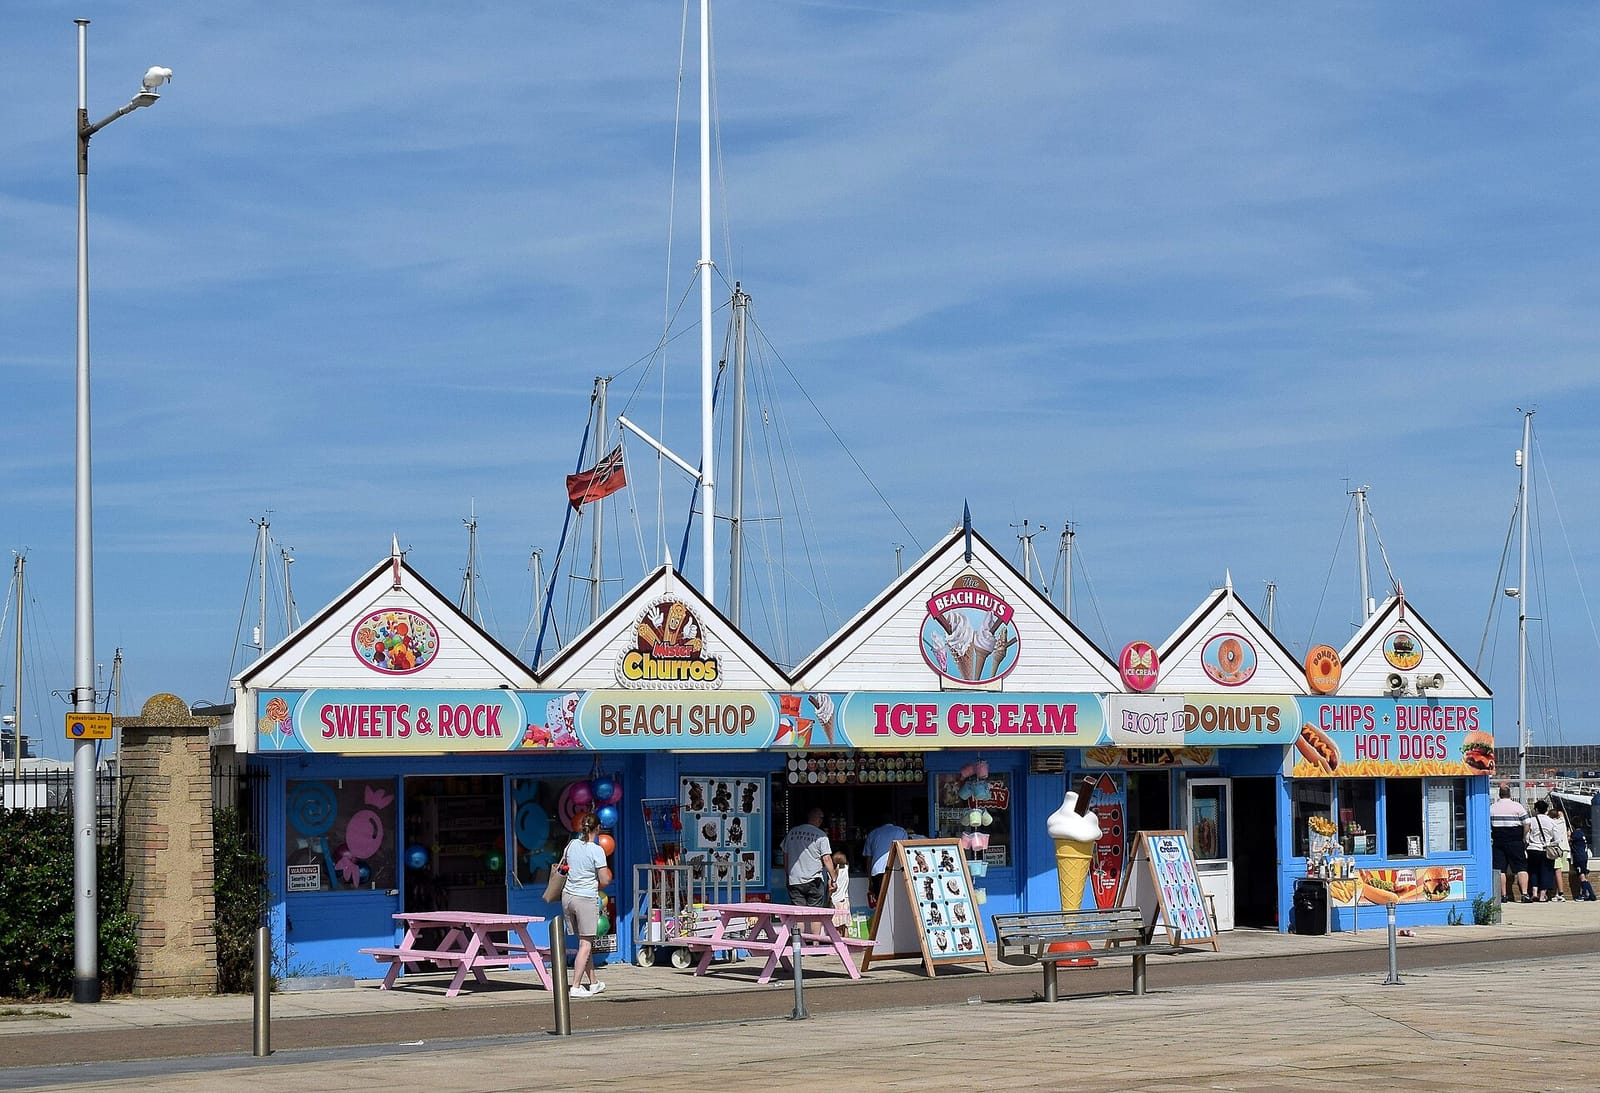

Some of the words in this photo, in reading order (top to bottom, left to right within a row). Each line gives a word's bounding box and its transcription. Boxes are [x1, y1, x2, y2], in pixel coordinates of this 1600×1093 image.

[961, 576, 979, 588] The
[935, 592, 973, 611] BEACH
[975, 592, 1006, 616] HUTS
[653, 642, 693, 658] Mister
[1313, 650, 1339, 667] DONUTS
[623, 651, 717, 681] Churros
[320, 704, 411, 739] SWEETS
[416, 707, 432, 736] &
[438, 704, 502, 738] ROCK
[600, 704, 683, 736] BEACH
[688, 704, 756, 736] SHOP
[873, 703, 939, 736] ICE
[946, 703, 1079, 736] CREAM
[1122, 710, 1168, 734] HOT
[1184, 704, 1281, 733] DONUTS
[1319, 705, 1375, 732] CHIPS
[1395, 705, 1480, 732] BURGERS
[1127, 748, 1175, 764] CHIPS
[1355, 734, 1392, 760] HOT
[1399, 734, 1448, 761] DOGS
